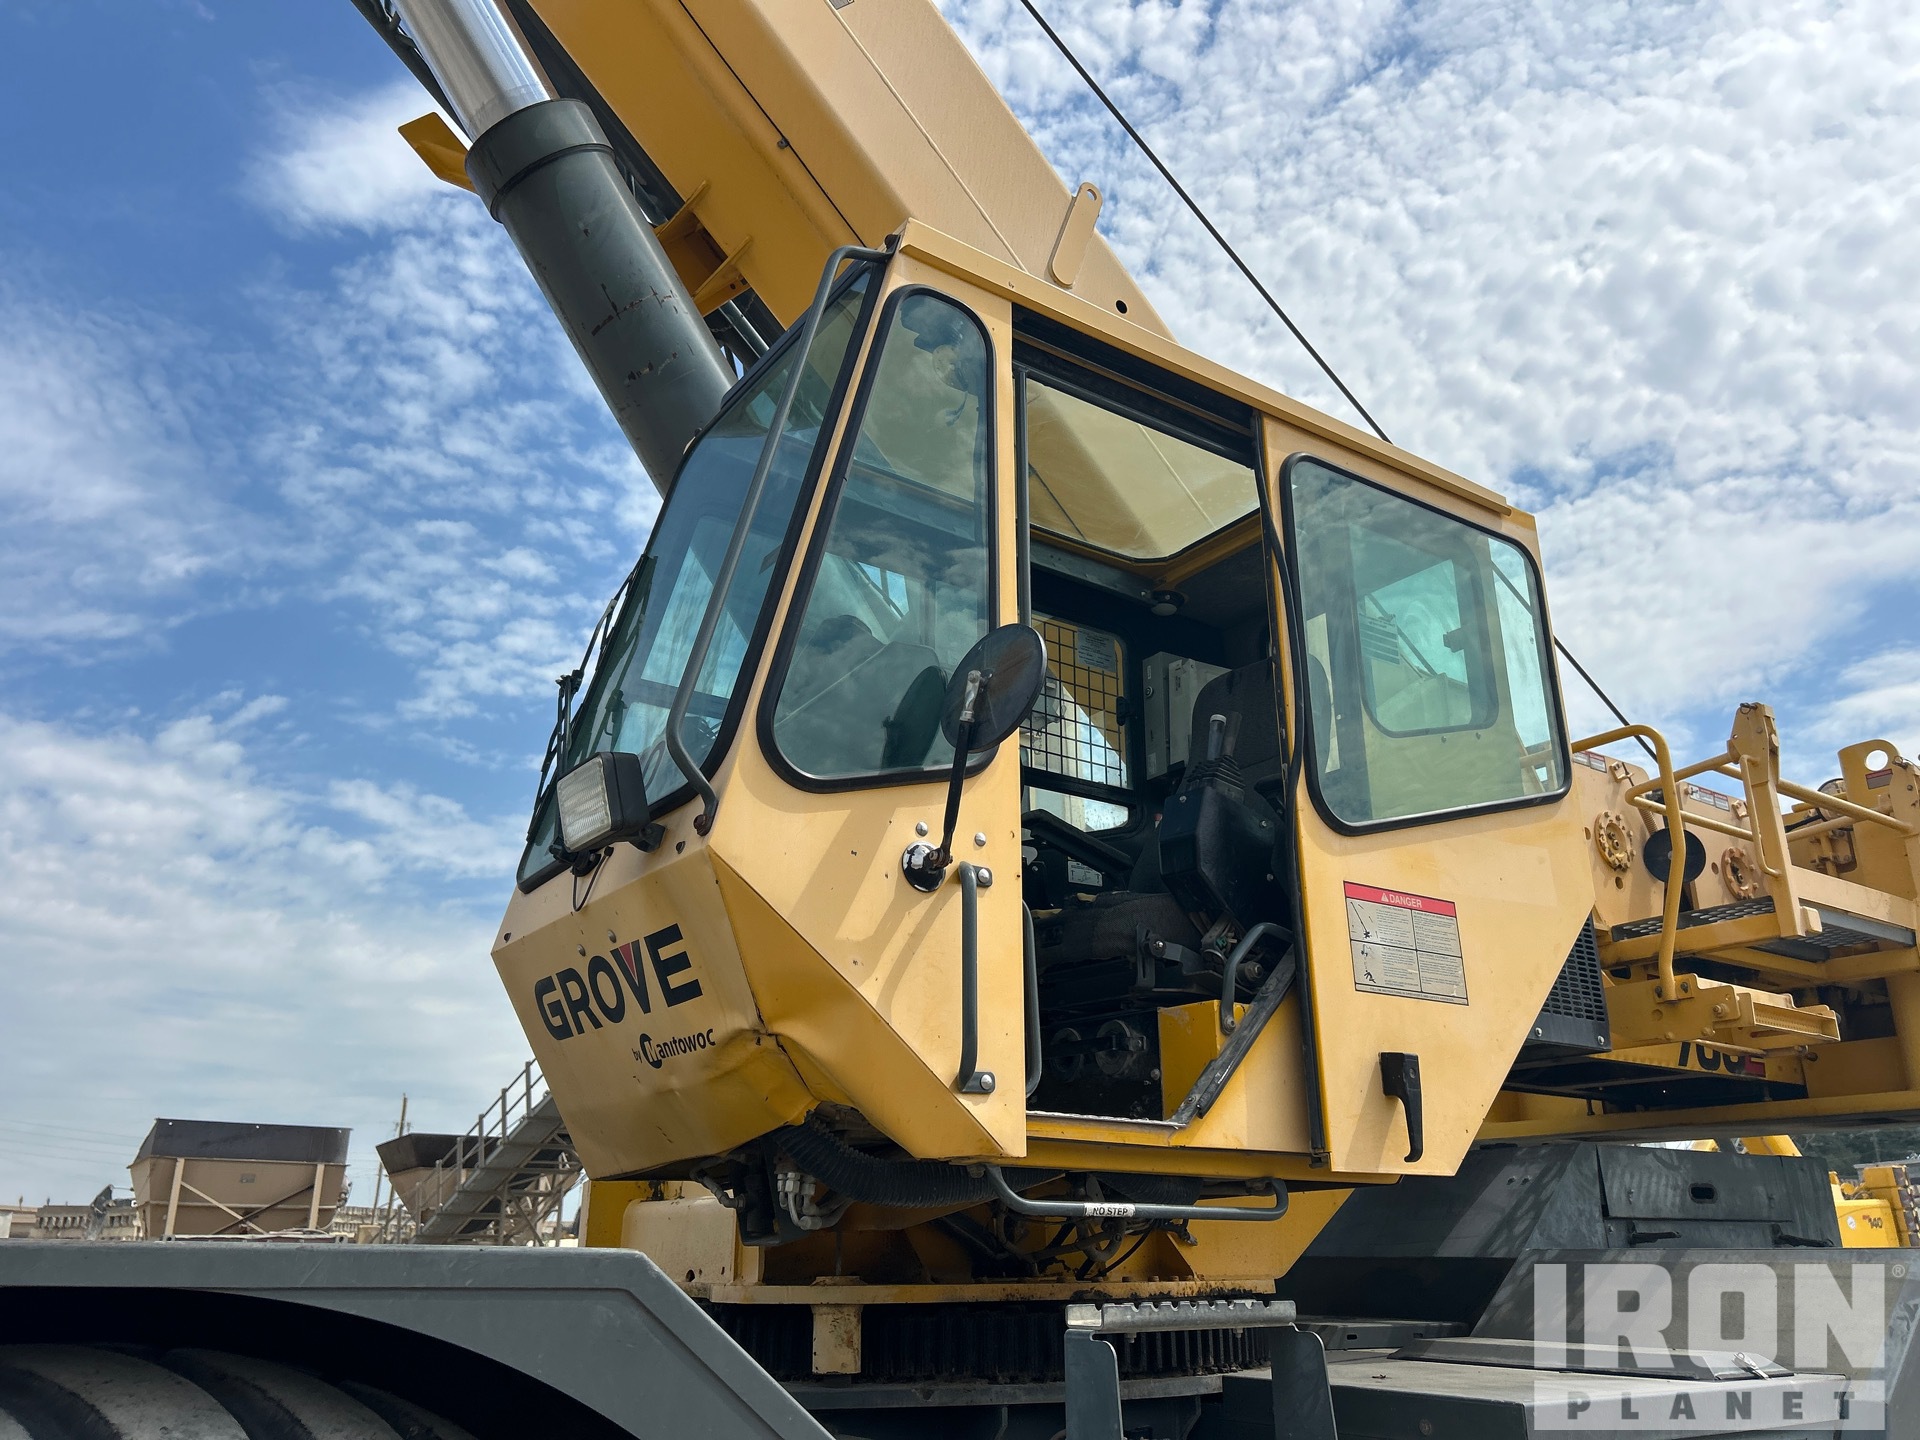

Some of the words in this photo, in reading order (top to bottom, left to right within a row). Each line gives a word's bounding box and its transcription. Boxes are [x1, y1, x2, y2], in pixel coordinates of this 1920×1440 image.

[1389, 893, 1422, 908] DANGER
[534, 923, 703, 1040] GROVE
[639, 1028, 716, 1069] Manitowoc
[1092, 1207, 1105, 1216] NO
[1107, 1207, 1128, 1216] STEP
